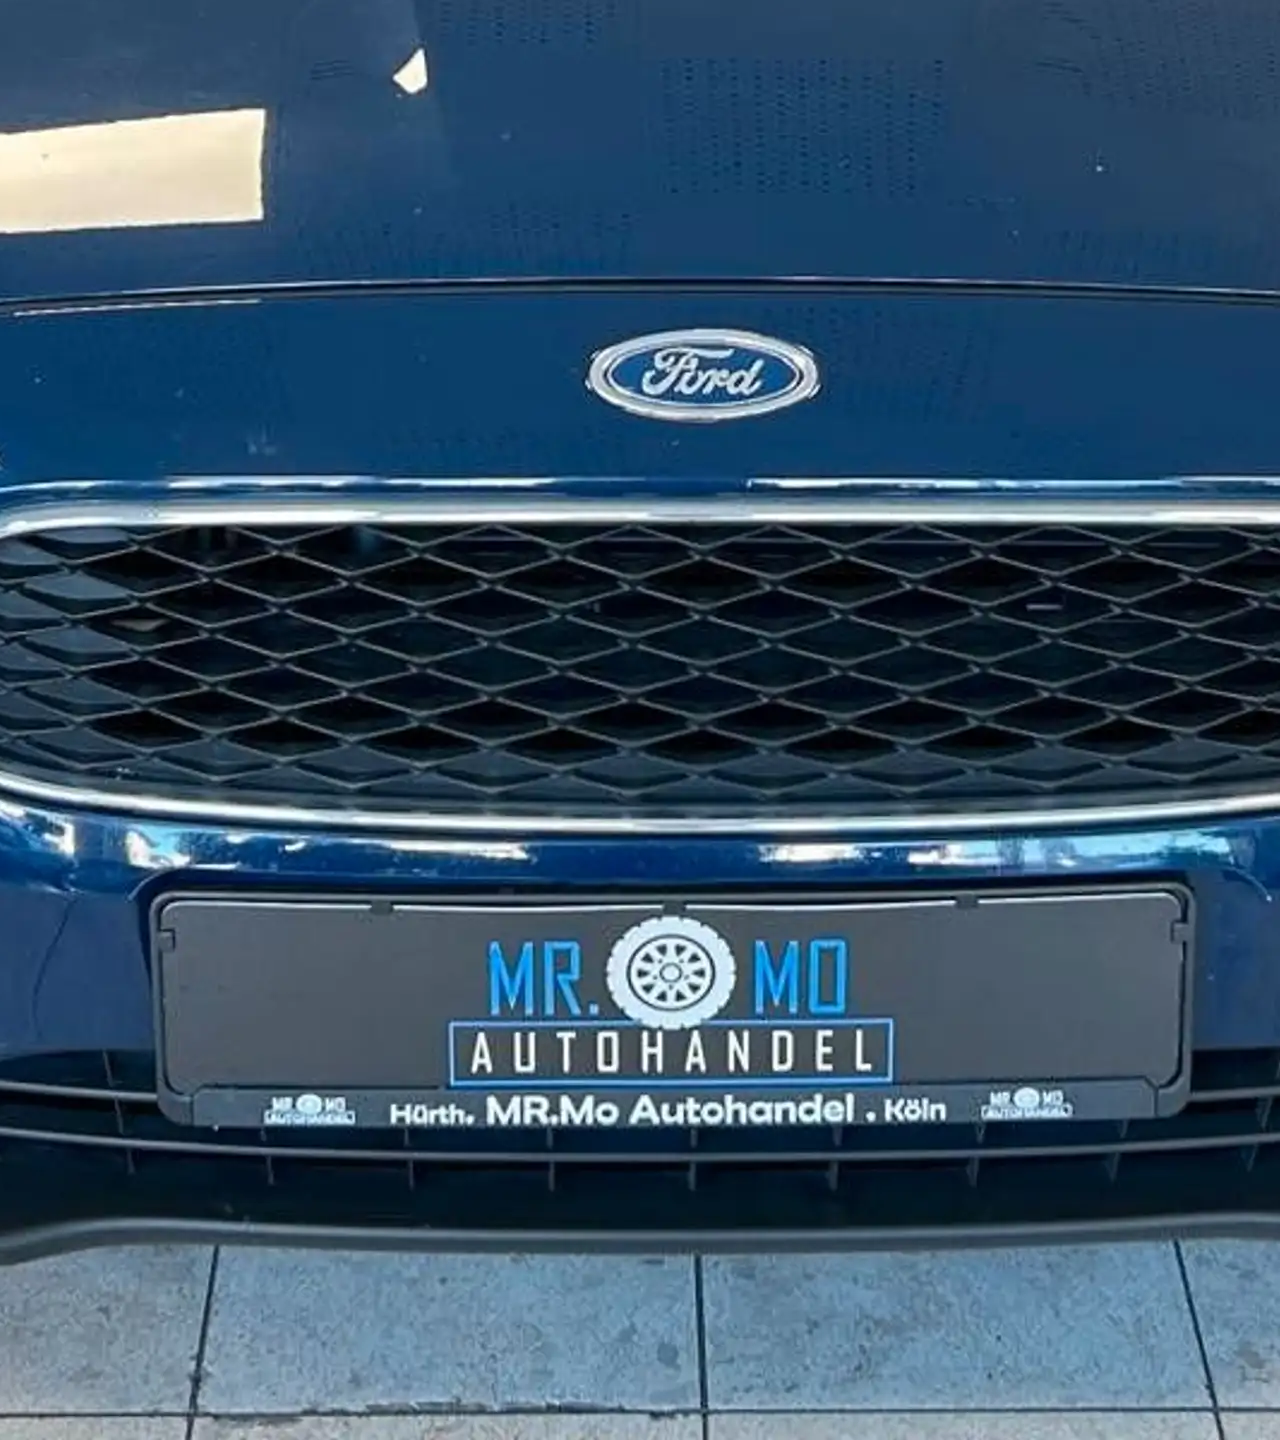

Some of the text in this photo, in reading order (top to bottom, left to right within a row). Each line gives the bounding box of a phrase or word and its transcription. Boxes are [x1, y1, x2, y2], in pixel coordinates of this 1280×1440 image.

[642, 347, 765, 396] Ford
[488, 939, 849, 1016] MR. MO
[470, 1029, 873, 1074] AUTOHANDEL
[628, 1092, 855, 1127] Autohandel
[884, 1097, 948, 1123] Köln
